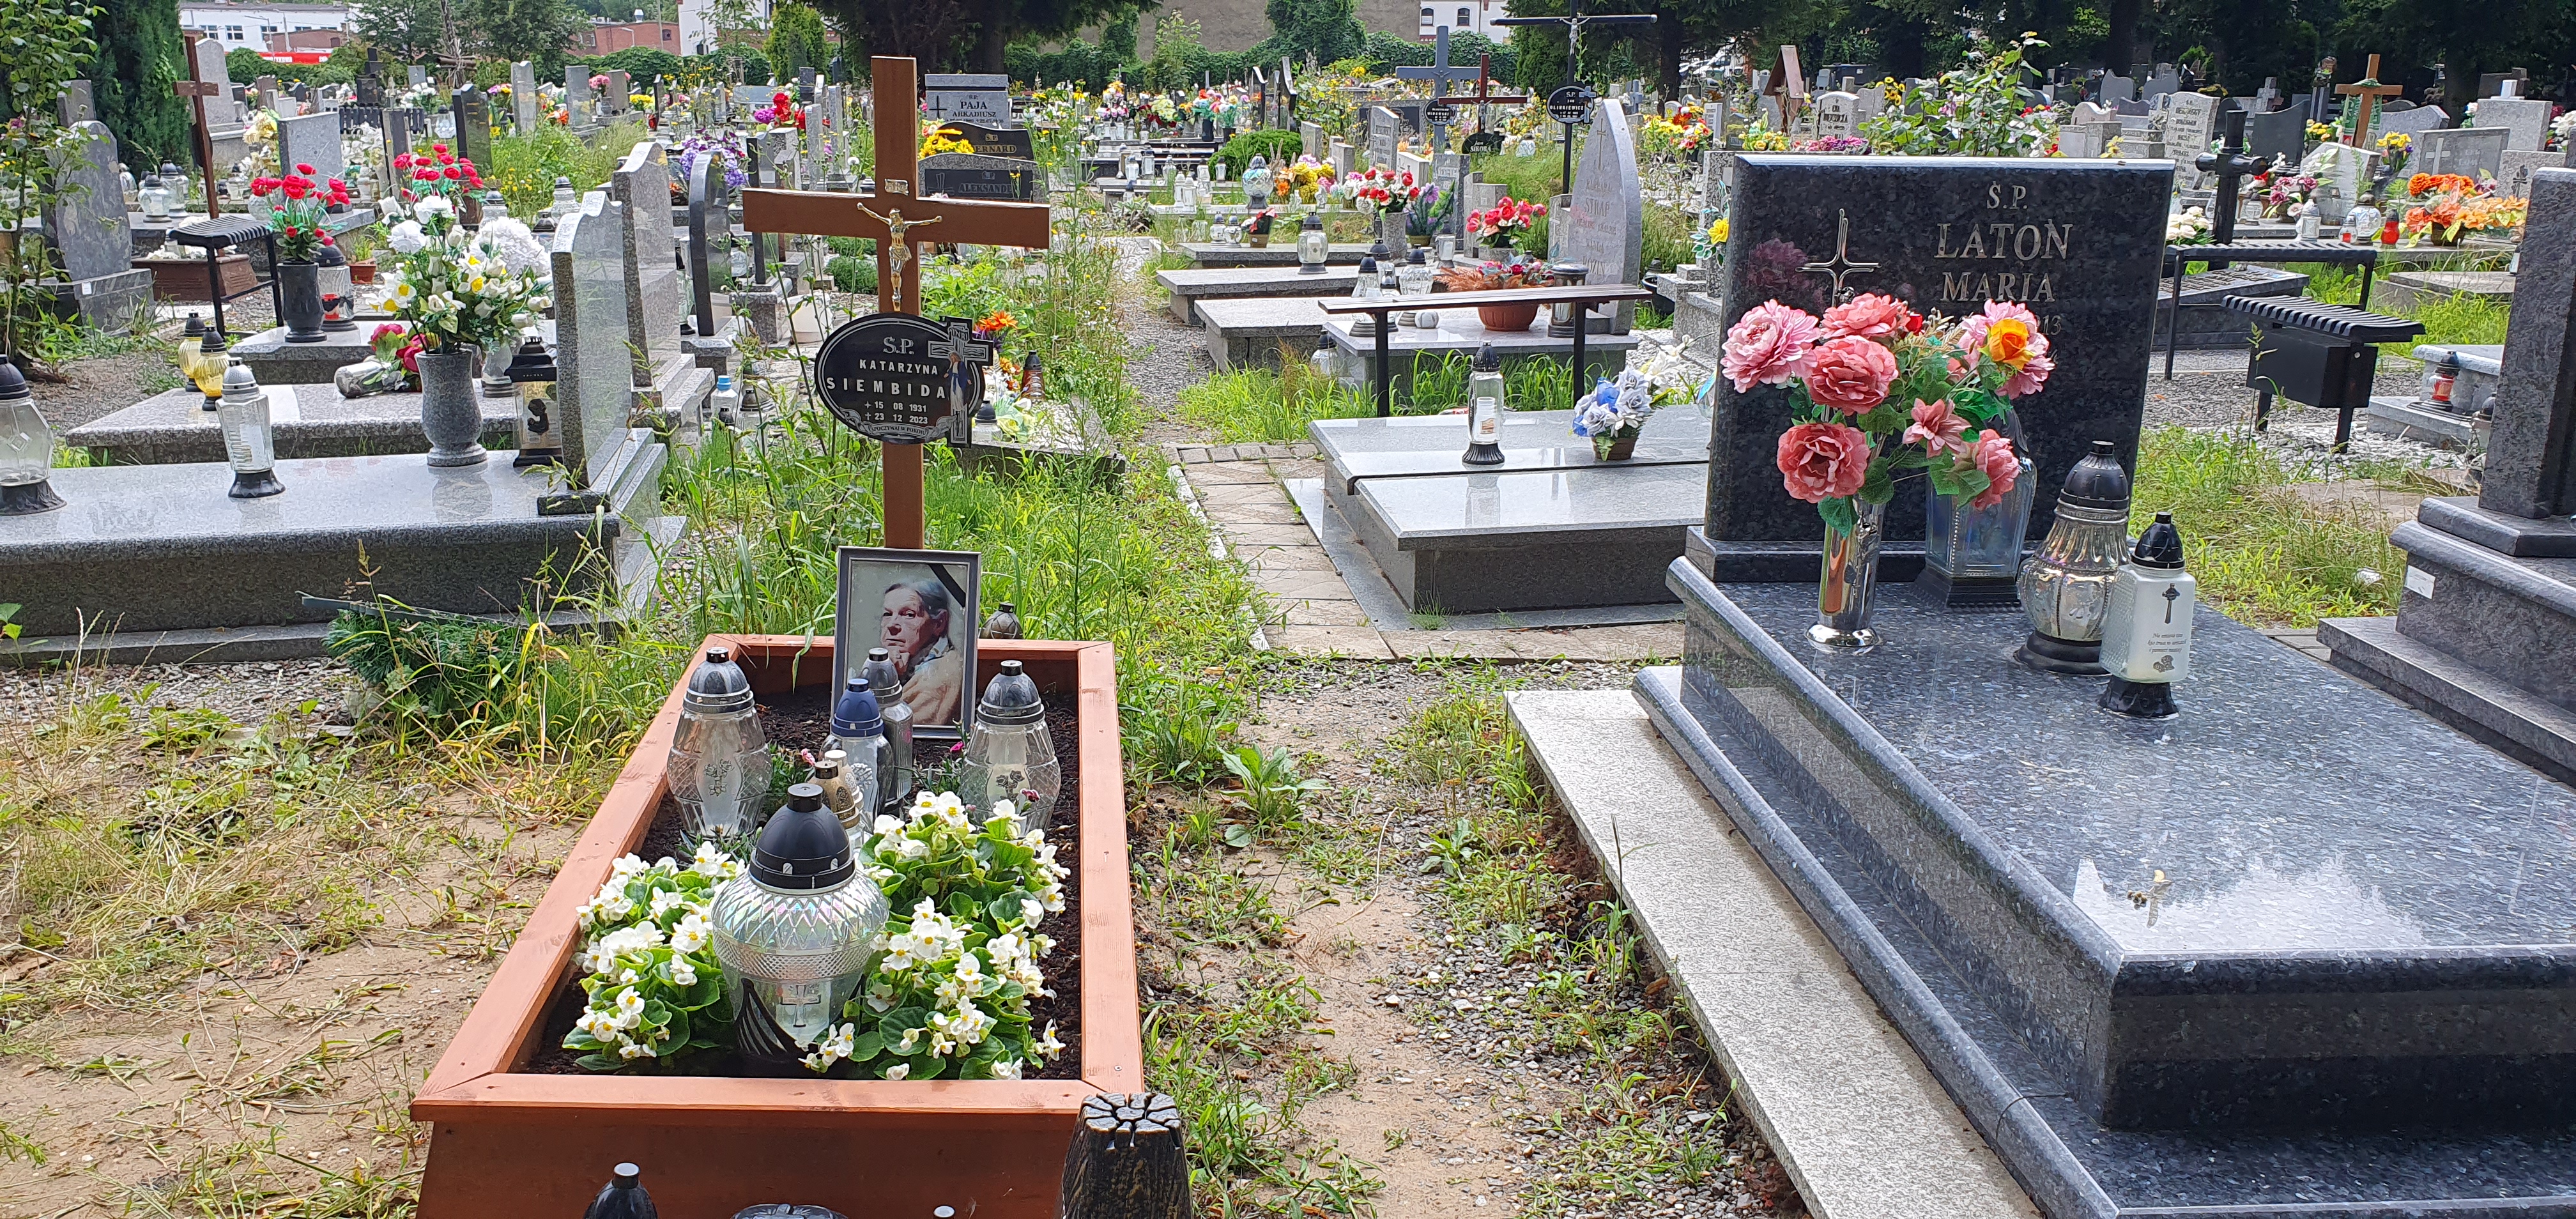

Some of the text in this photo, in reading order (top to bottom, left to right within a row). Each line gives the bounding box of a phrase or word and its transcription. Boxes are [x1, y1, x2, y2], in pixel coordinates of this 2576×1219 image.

[960, 100, 988, 109] PAJA
[959, 183, 1013, 194] ALEKSANDE
[1940, 272, 2055, 302] MARIA
[859, 359, 938, 375] KATARZYNA
[826, 377, 946, 399] SIEMBIDA
[875, 401, 926, 413] 15 08 1931
[875, 413, 928, 424] 23 12 2023
